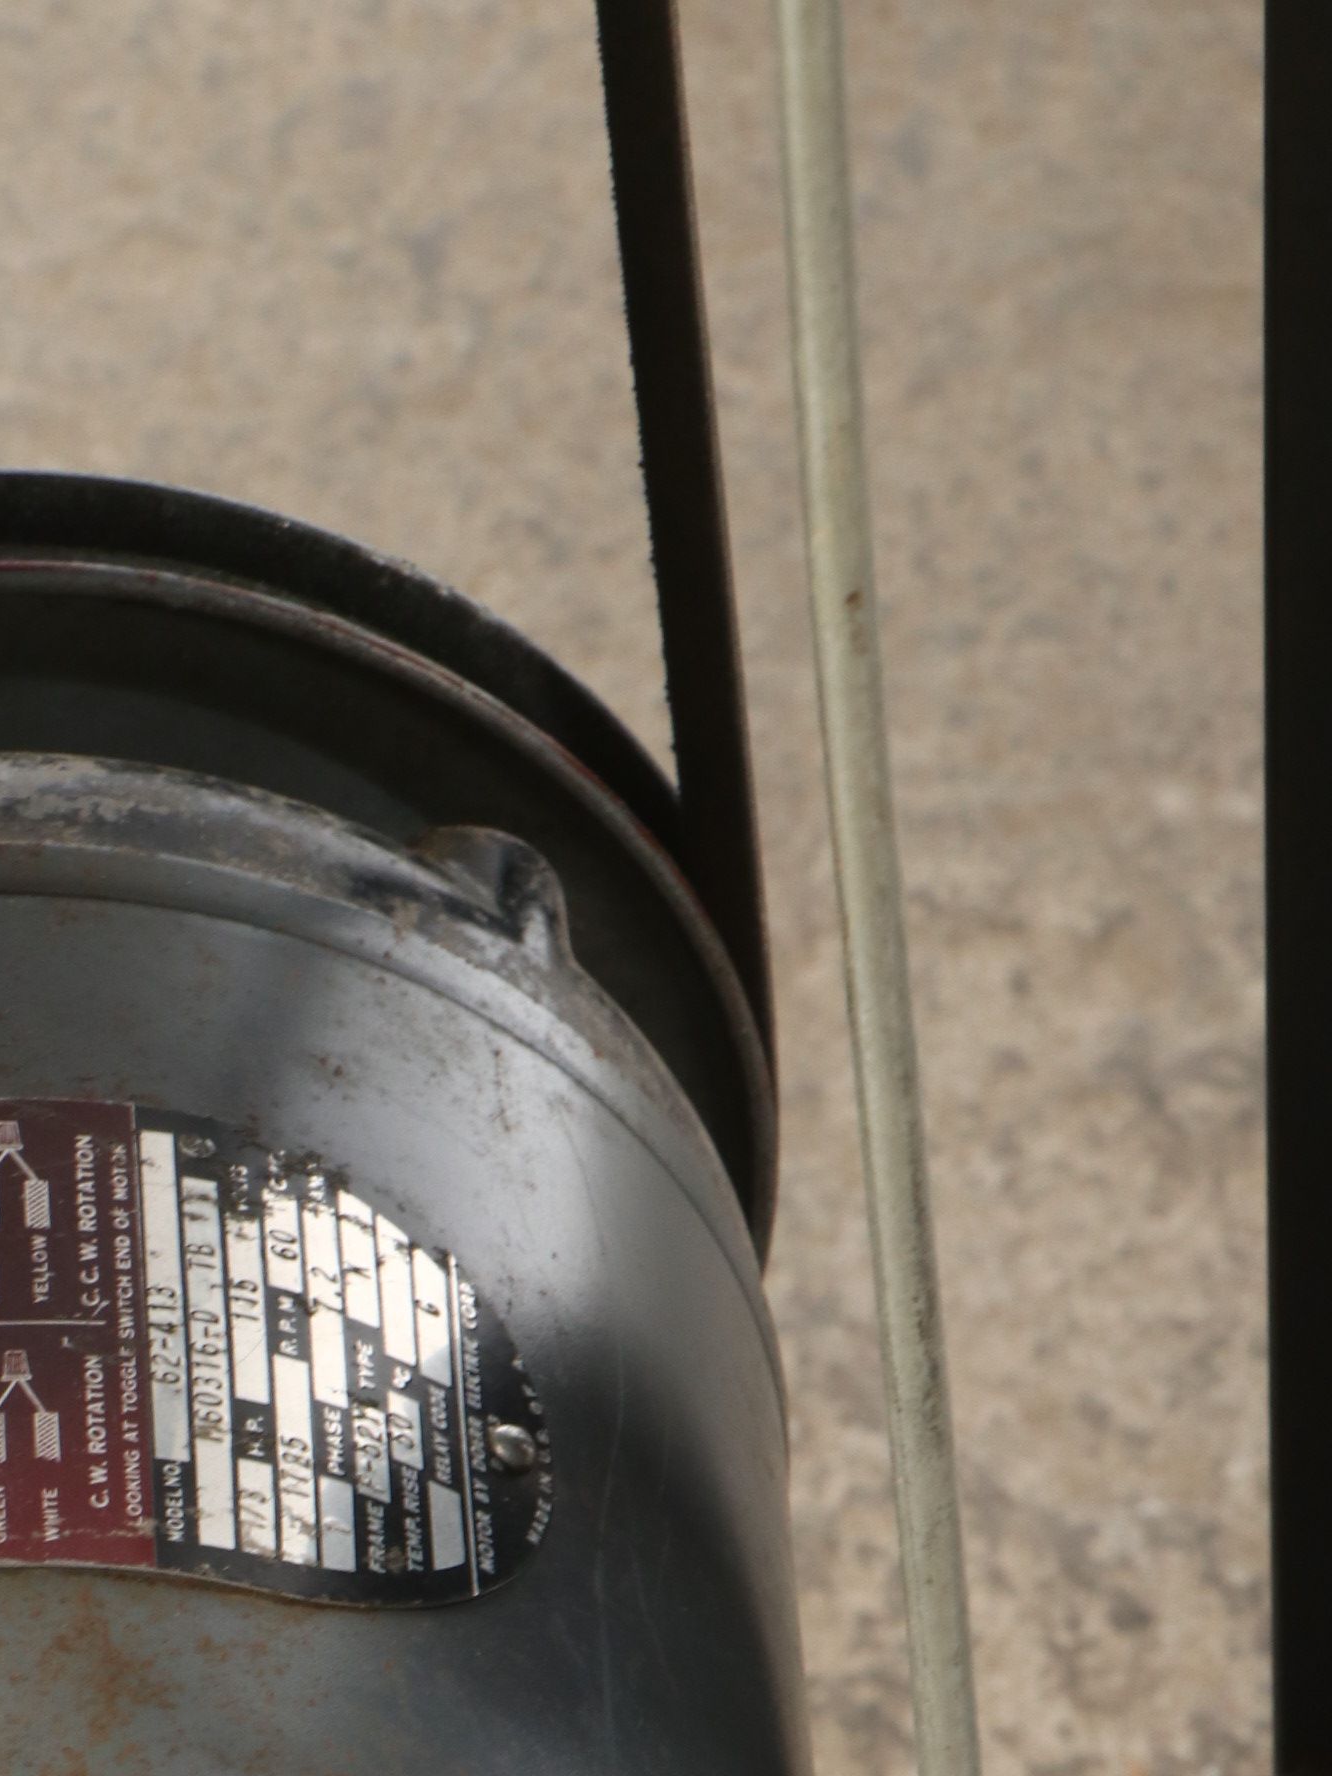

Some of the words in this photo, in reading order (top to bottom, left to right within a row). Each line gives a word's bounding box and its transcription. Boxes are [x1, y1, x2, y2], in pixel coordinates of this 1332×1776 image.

[74, 1134, 97, 1232] ROTATION
[110, 1144, 127, 1200] MOTOR
[112, 1207, 130, 1228] OF
[270, 1229, 298, 1260] 60
[30, 1235, 49, 1302] YELLOW
[113, 1236, 131, 1270] END
[116, 1276, 135, 1339] SWITCH
[229, 1278, 259, 1322] 115
[120, 1346, 136, 1414] TOGGLE
[352, 1339, 376, 1390] TYPE
[85, 1355, 106, 1454] ROTATION
[122, 1420, 138, 1443] AT
[323, 1406, 346, 1476] PHASE
[433, 1433, 452, 1484] RELAY
[42, 1488, 60, 1542] WHITE
[122, 1451, 142, 1526] LOOKING
[401, 1466, 420, 1514] RISE
[166, 1492, 184, 1542] MODEL
[366, 1500, 386, 1573] FRAME
[403, 1516, 424, 1571] TEMP.
[474, 1510, 496, 1574] MOTOR
